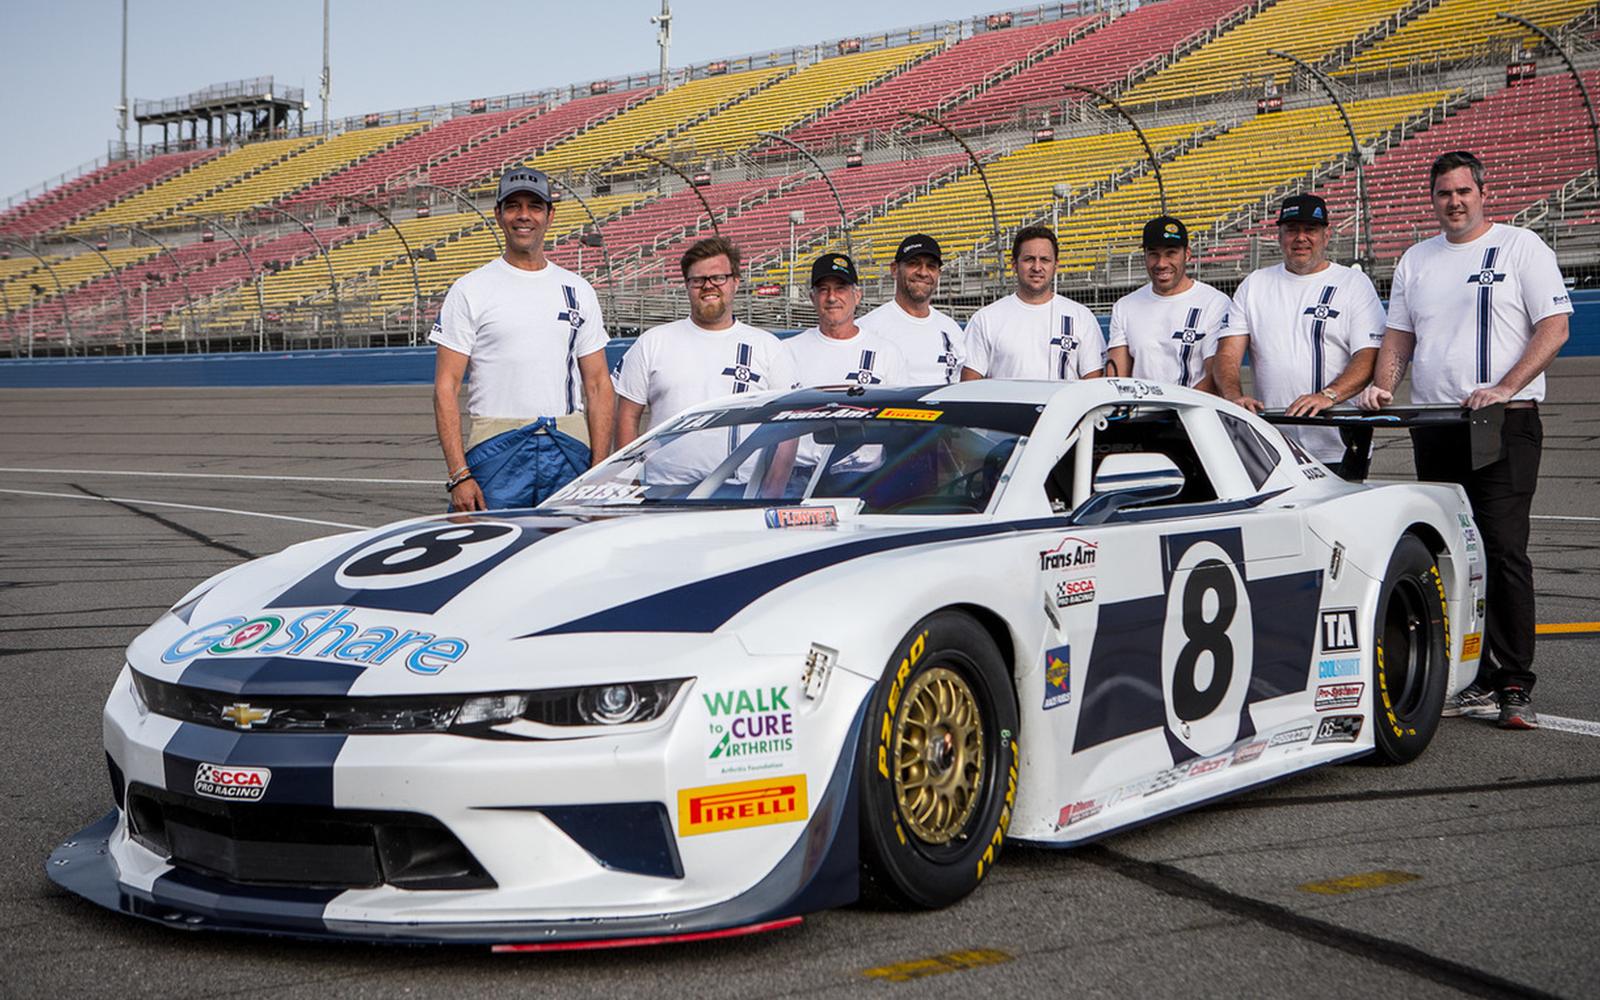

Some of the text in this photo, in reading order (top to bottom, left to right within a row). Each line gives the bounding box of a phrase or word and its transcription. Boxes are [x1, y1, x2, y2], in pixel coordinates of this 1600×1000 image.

[1482, 271, 1492, 284] 8
[1317, 306, 1327, 319] 8
[1062, 337, 1072, 350] 8
[1184, 330, 1194, 343] 8
[738, 368, 749, 381] 8
[860, 372, 870, 384] 8
[884, 410, 936, 419] PIRELLI
[343, 523, 514, 577] 8
[1039, 545, 1096, 571] Trans Am
[1066, 580, 1094, 594] SCCA
[1323, 613, 1355, 648] TA
[1172, 558, 1238, 723] 8
[703, 686, 790, 717] WALK
[709, 714, 793, 739] to CURE
[709, 731, 793, 759] ARTHRITIS
[211, 769, 263, 786] SCCA
[196, 782, 261, 797] PRO RACING
[689, 785, 796, 825] PIRELLI
